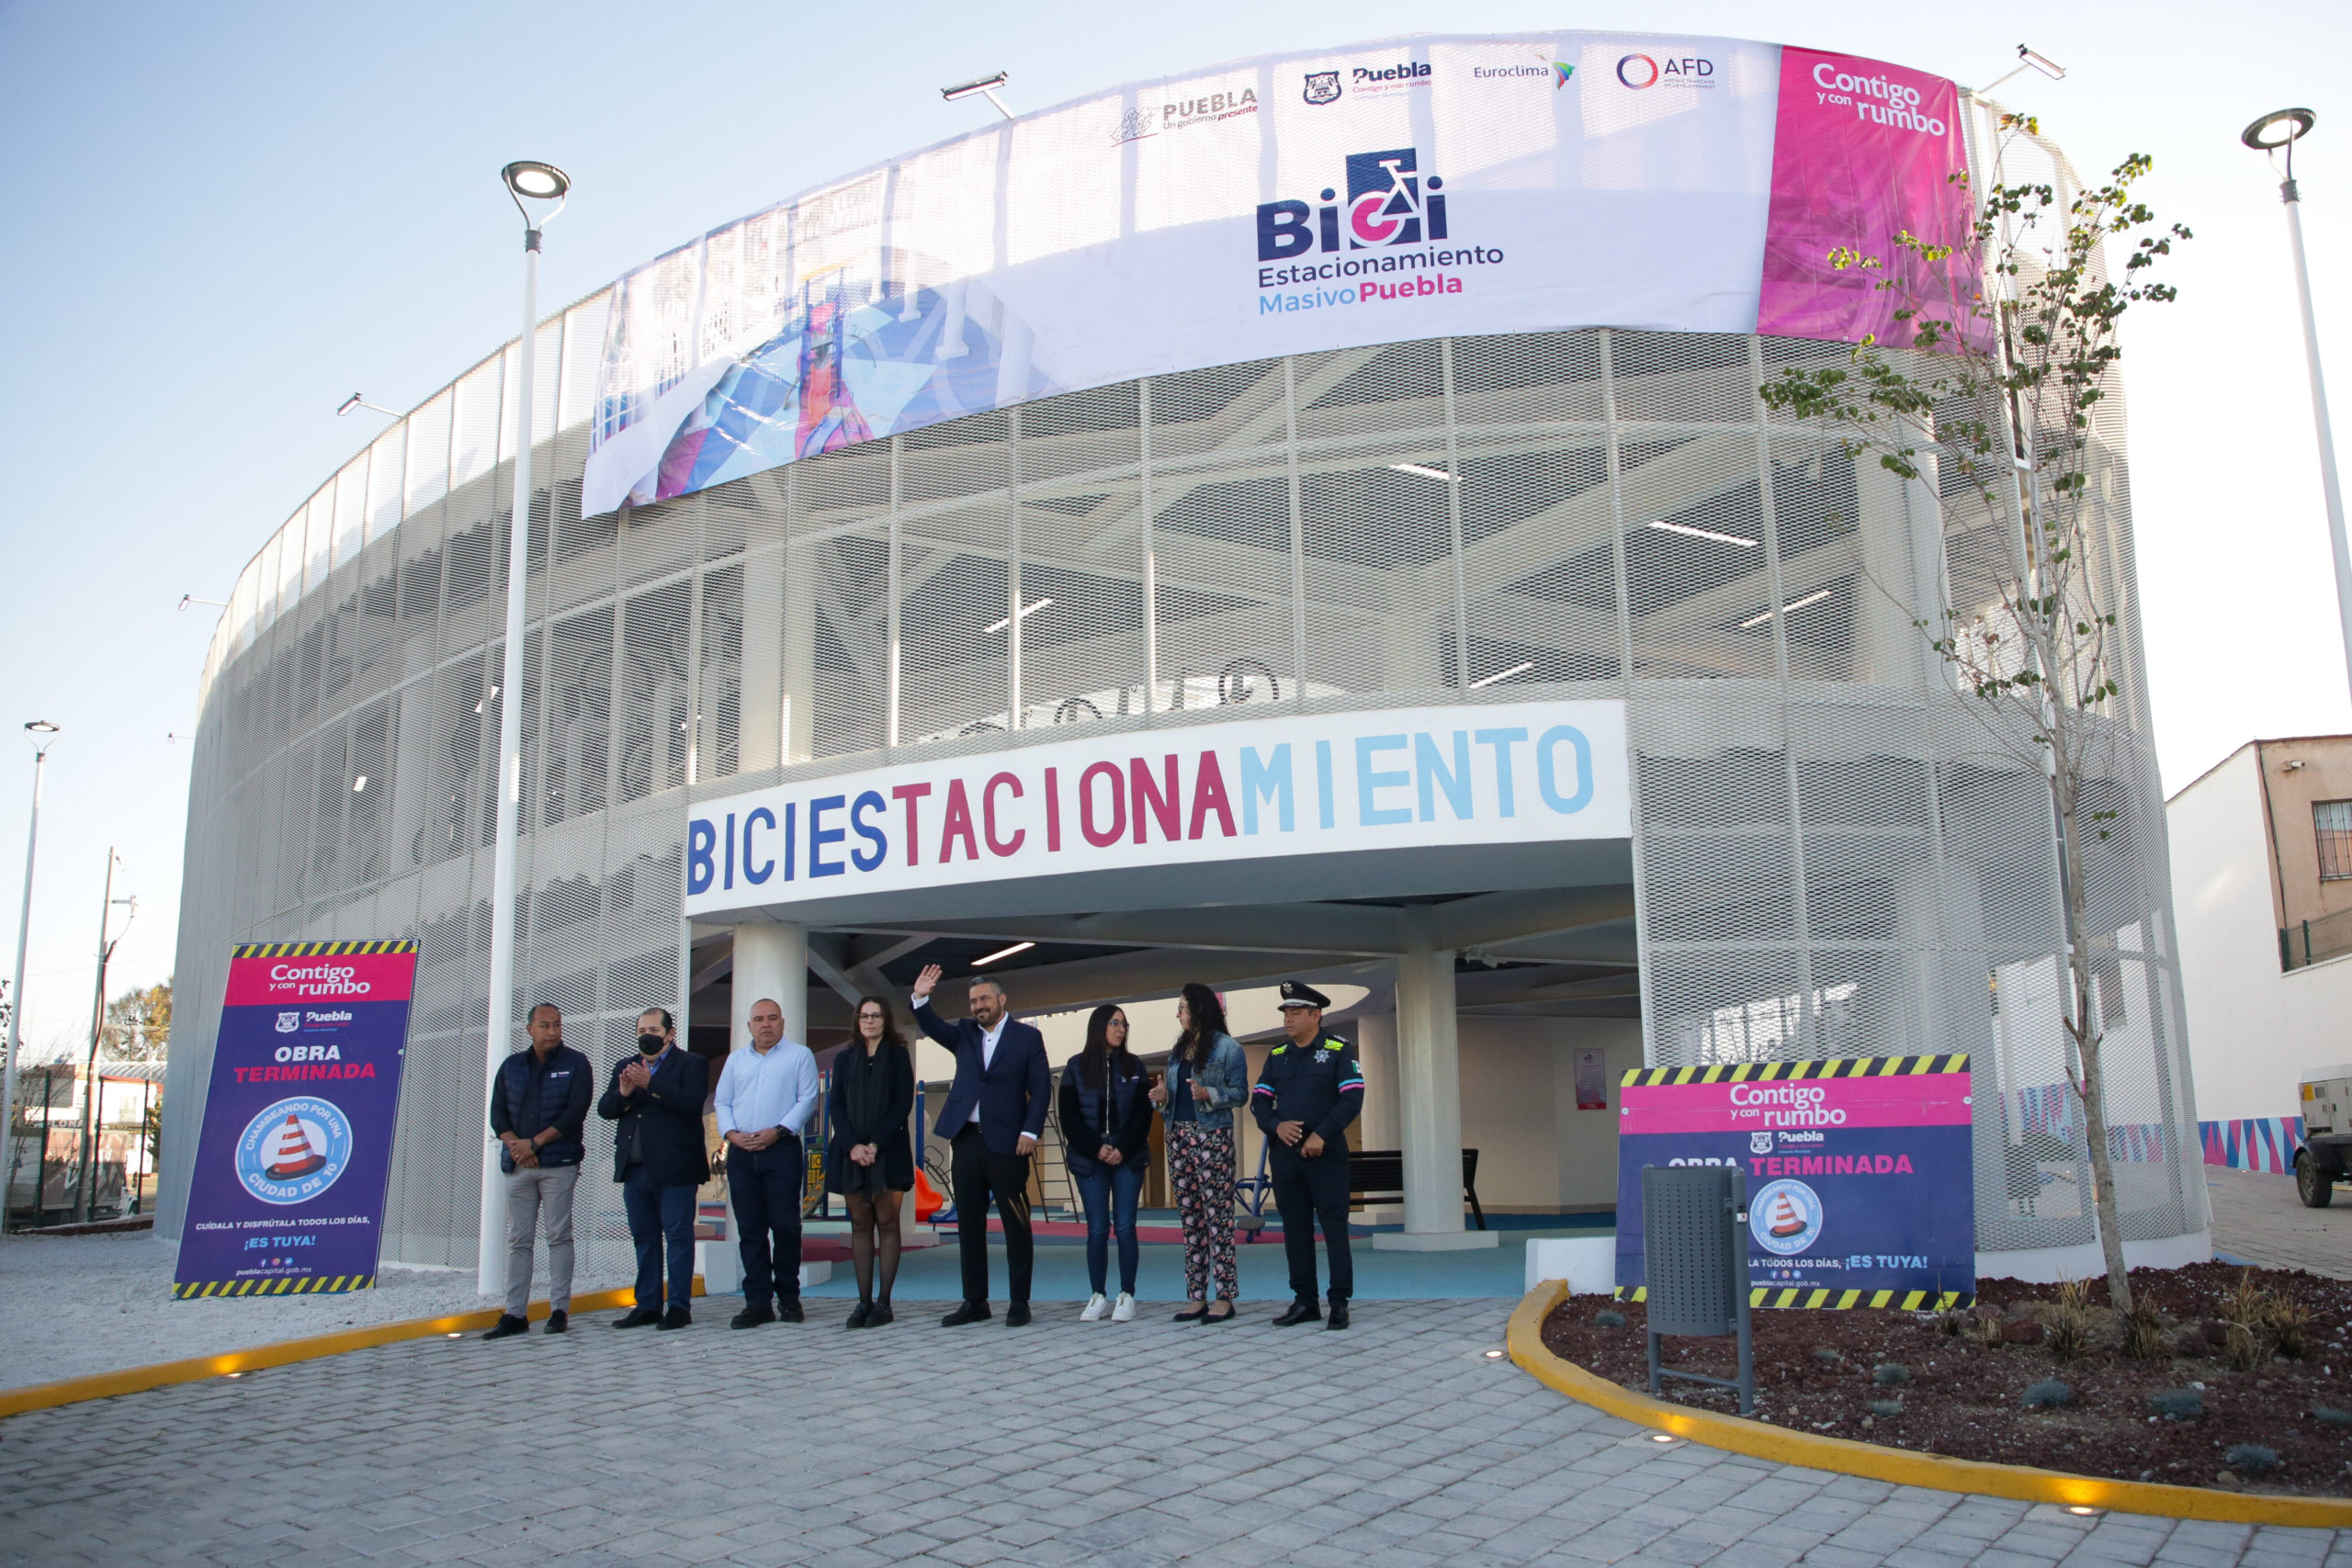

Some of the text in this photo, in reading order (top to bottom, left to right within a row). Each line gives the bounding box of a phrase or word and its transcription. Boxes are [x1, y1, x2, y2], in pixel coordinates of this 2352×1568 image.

[1352, 61, 1431, 84] Puebla
[1474, 65, 1548, 78] Euroclima
[1664, 58, 1713, 75] AFD
[1352, 85, 1383, 93] Contigo
[1406, 79, 1431, 88] rumbo
[1813, 62, 1920, 109] Contigo
[1163, 87, 1257, 120] PUEBLA
[1163, 105, 1258, 130] Un gobierno presente
[1816, 92, 1946, 136] y con rumbo
[1258, 245, 1504, 288] Estacionamiento
[687, 723, 1594, 896] BICIESTACIONAMIENTO
[270, 964, 355, 983] Contigo
[269, 983, 277, 991] y
[299, 978, 371, 996] rumbo
[306, 1010, 353, 1021] Puebla
[275, 1044, 341, 1063] OBRA
[233, 1063, 376, 1083] TERMINADA
[1729, 1082, 1825, 1110] Contigo
[1730, 1103, 1847, 1126] y con rumbo
[245, 1102, 343, 1150] CHAMBEANDO POR UNA
[1778, 1131, 1824, 1142] Puebla
[1749, 1154, 1914, 1176] TERMINADA
[248, 1163, 338, 1198] CIUDAD DE 10
[196, 1221, 233, 1230] CUÍDALA
[243, 1218, 296, 1228] DISFRÚTALA
[298, 1218, 327, 1226] TODOS
[347, 1215, 370, 1224] DÍAS,
[243, 1235, 316, 1251] ¡ES TUYA!
[1759, 1227, 1815, 1249] CIUDAD DE 10
[236, 1266, 312, 1277] pueblacapital.gob.mx
[1761, 1258, 1792, 1268] TODOS
[1795, 1258, 1814, 1268] LOS
[1815, 1258, 1841, 1269] DÍAS,
[1846, 1256, 1872, 1270] ¡ES
[1876, 1256, 1928, 1269] TUYA!
[1751, 1280, 1820, 1288] pueblacapital.gob.mx
